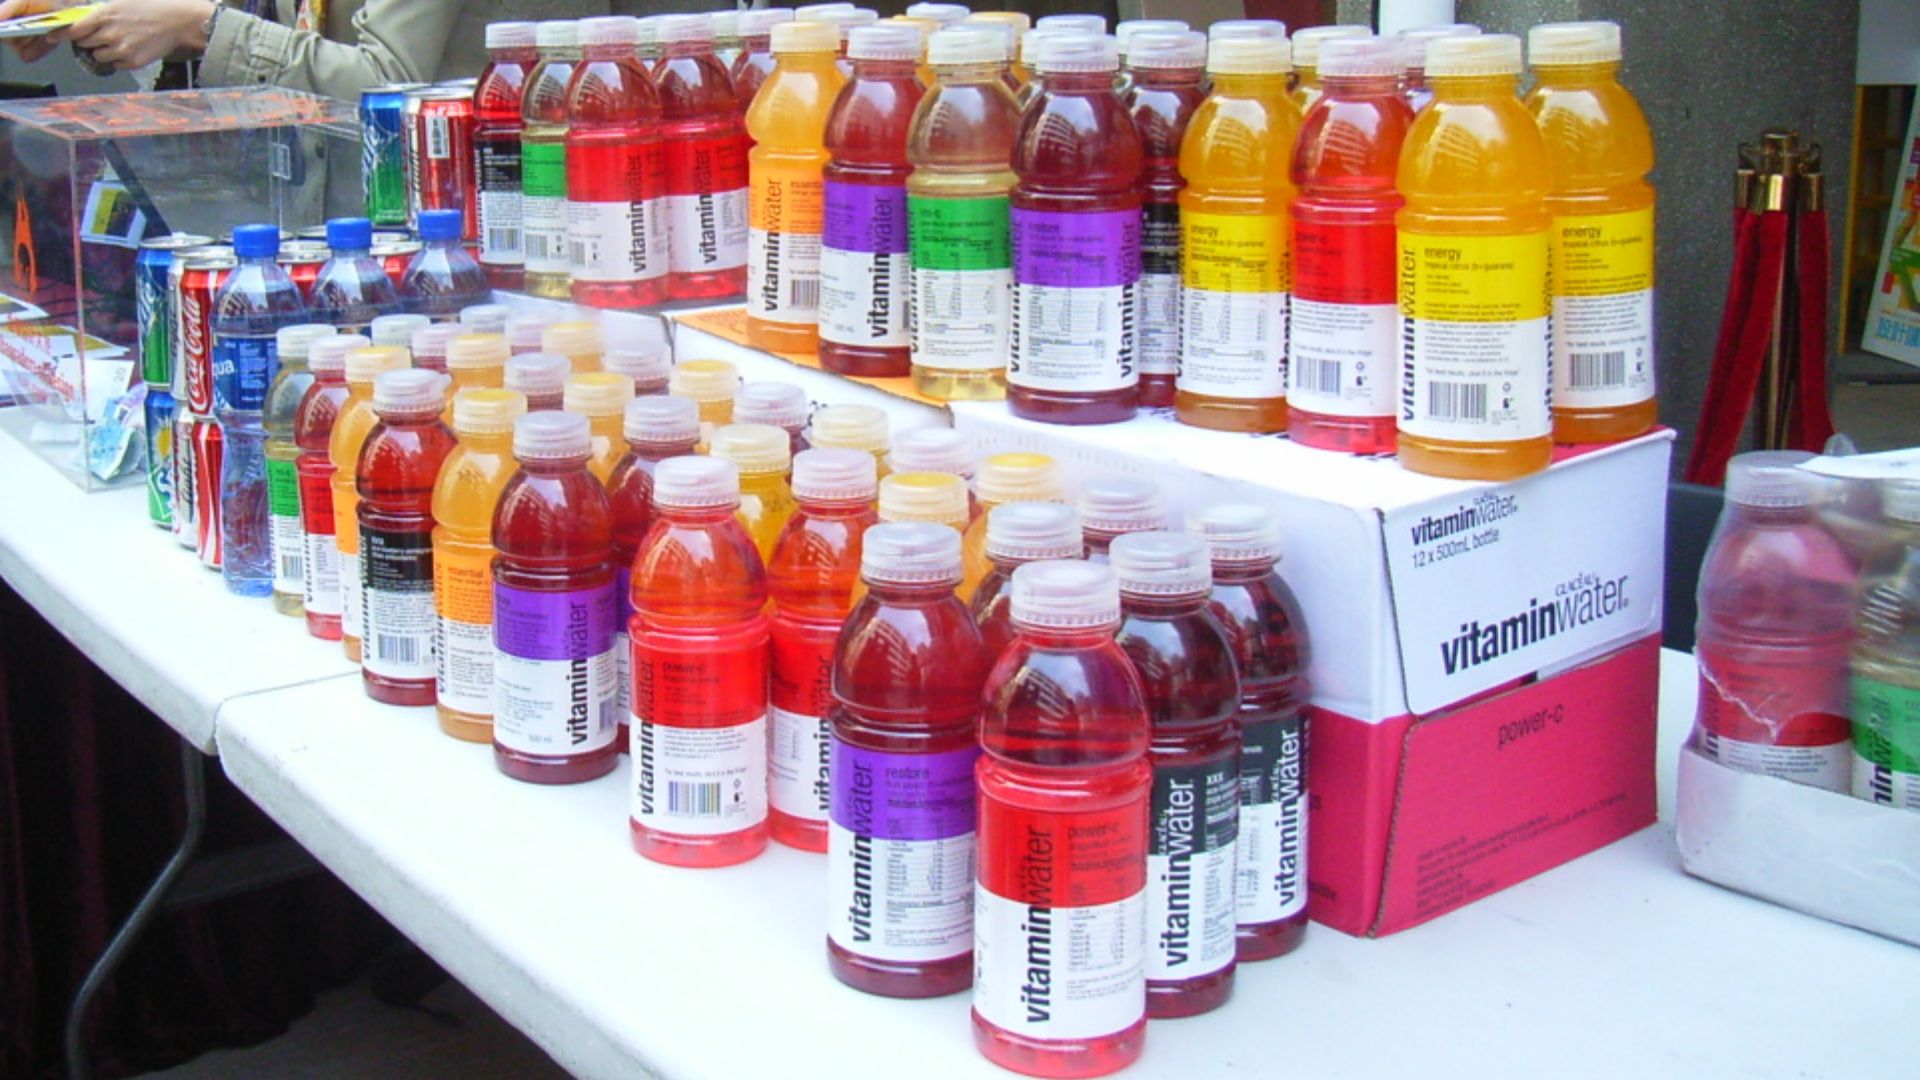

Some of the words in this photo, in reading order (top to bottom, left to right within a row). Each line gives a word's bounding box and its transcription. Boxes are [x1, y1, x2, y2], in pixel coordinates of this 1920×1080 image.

[762, 177, 782, 312] vitaminwater
[868, 195, 892, 338] vitaminwater
[1117, 221, 1138, 379] vitaminwater
[1424, 247, 1462, 260] energy
[1563, 227, 1602, 239] energy
[1402, 246, 1416, 420] vitaminwater
[1412, 550, 1425, 568] 12
[1427, 549, 1435, 563] x
[1436, 536, 1471, 561] 500mL
[1472, 527, 1499, 549] bottle
[565, 602, 588, 745] vitaminwater
[1498, 703, 1564, 751] power-c
[848, 759, 873, 943] vitaminwater
[1021, 825, 1053, 1024] vitaminwater
